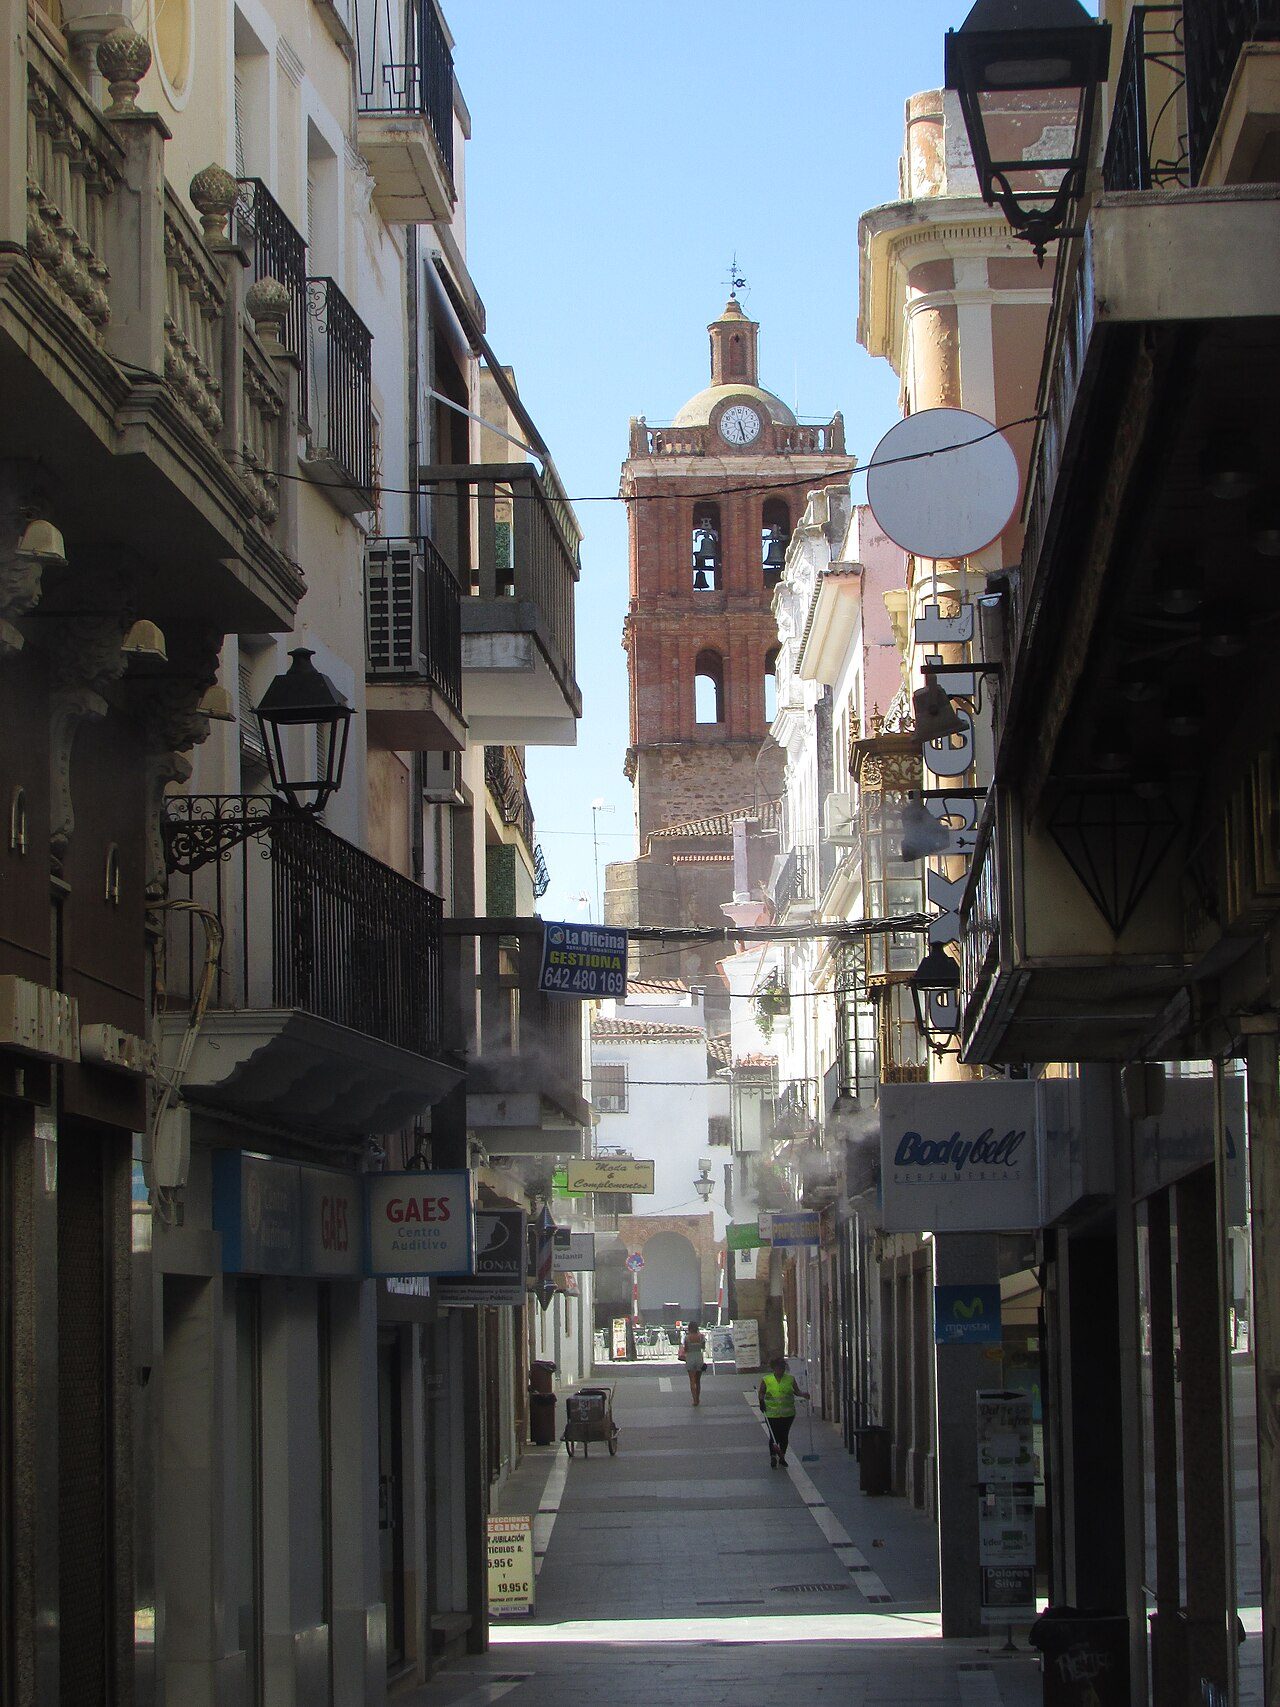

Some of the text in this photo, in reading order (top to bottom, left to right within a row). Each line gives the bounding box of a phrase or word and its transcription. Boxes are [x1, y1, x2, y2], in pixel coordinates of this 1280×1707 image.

[566, 930, 625, 949] La Oficina
[550, 951, 622, 970] GESTIONA
[544, 967, 623, 993] 642 480 169
[894, 1128, 1026, 1170] Bodybell
[594, 1162, 627, 1172] Moda
[573, 1178, 648, 1190] Complementos
[386, 1197, 450, 1224] GAES
[398, 1227, 440, 1238] Centro
[392, 1240, 447, 1250] Auditivo
[492, 1533, 525, 1543] JUBILACIÓN
[987, 1568, 1030, 1578] Dolores
[497, 1582, 521, 1593] 19,95
[994, 1579, 1022, 1589] Silva
